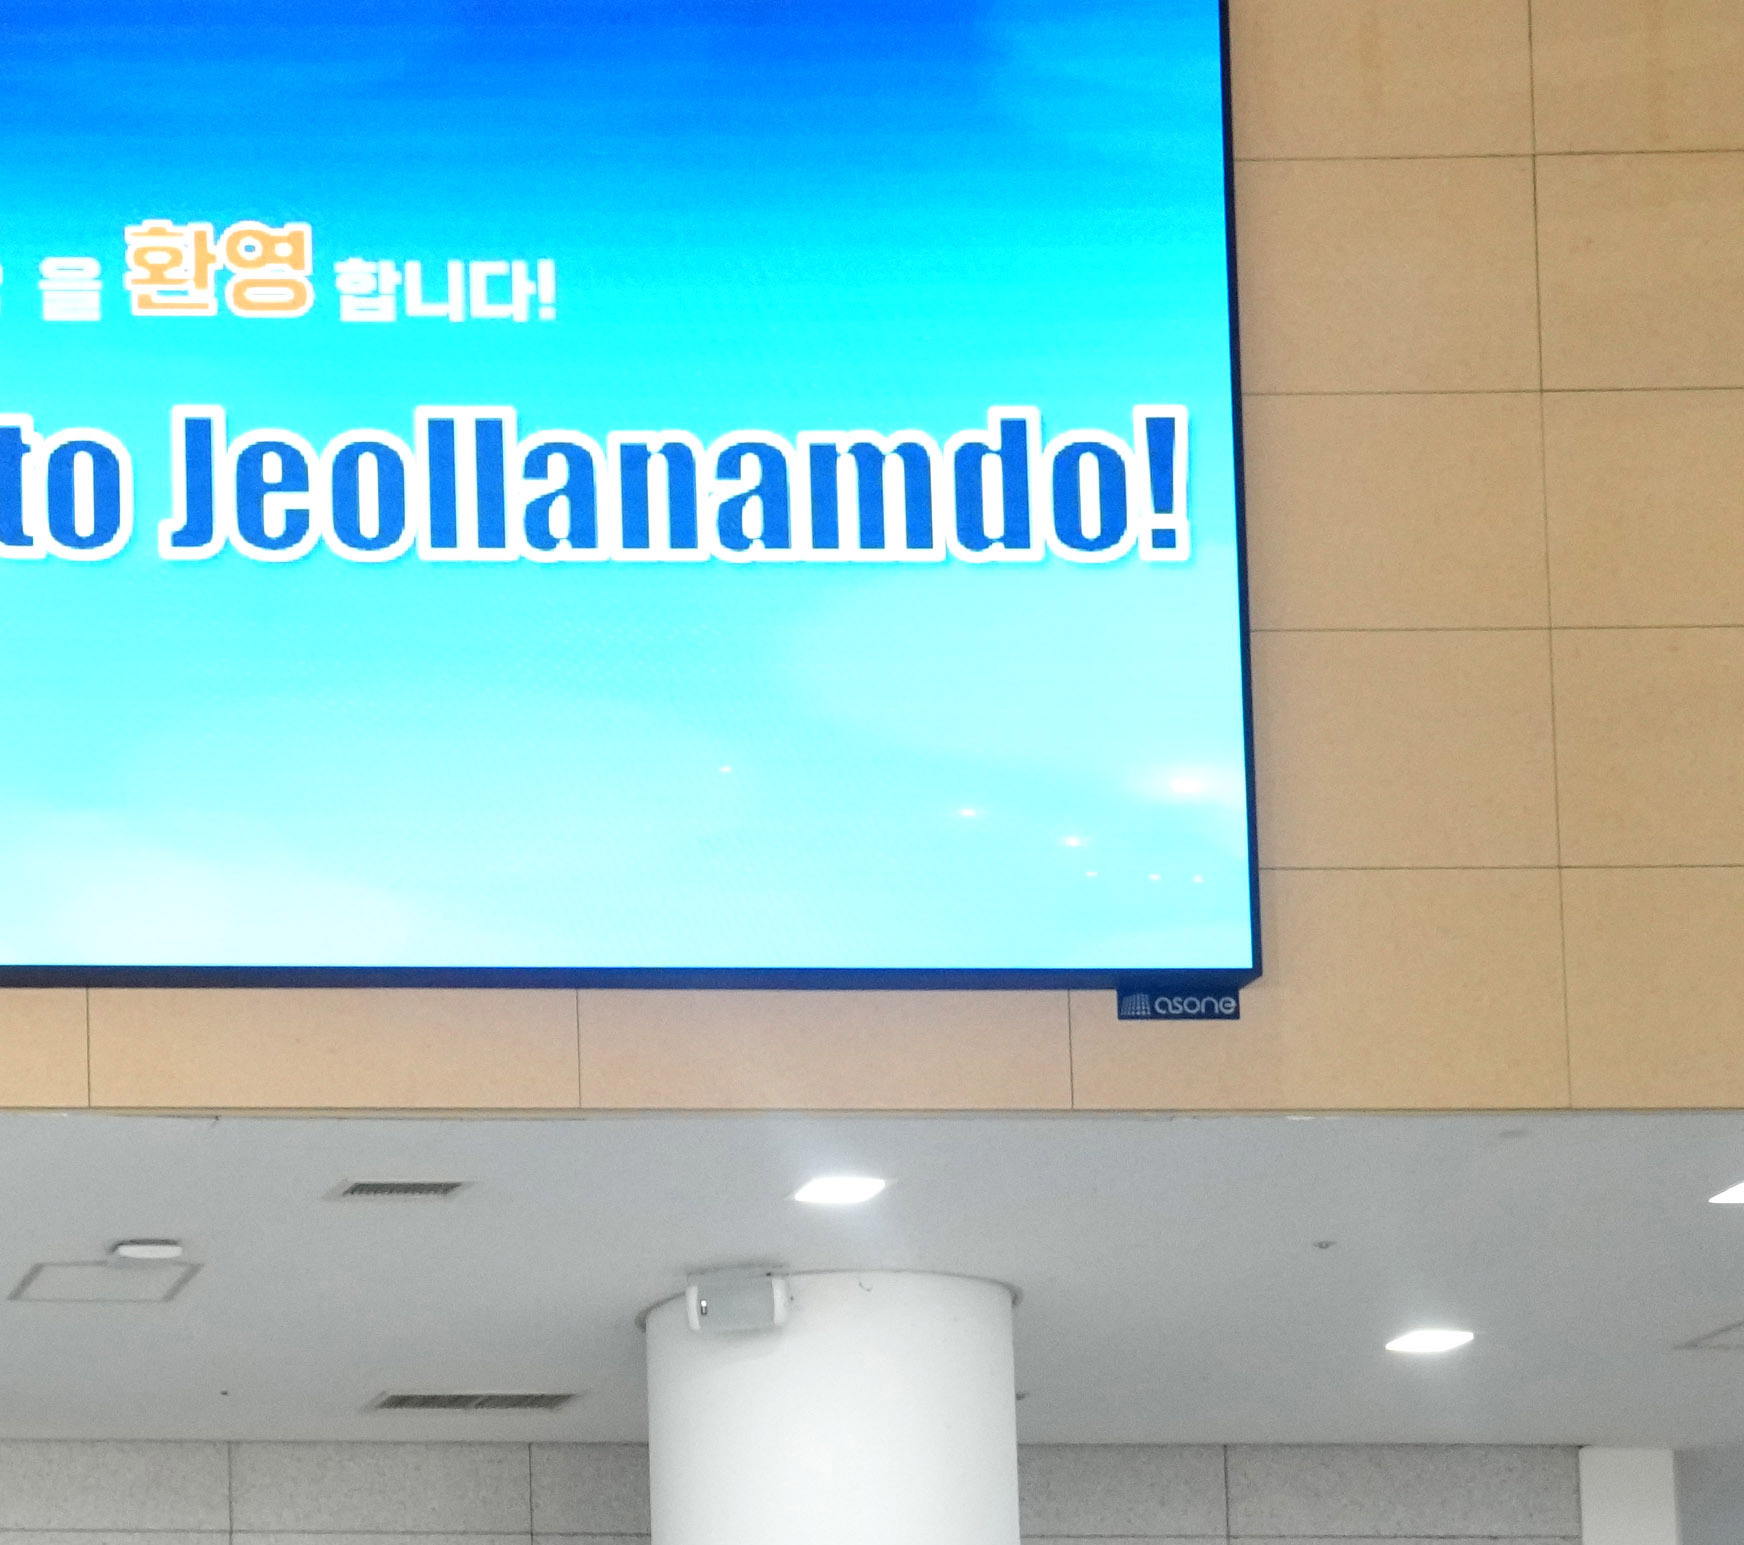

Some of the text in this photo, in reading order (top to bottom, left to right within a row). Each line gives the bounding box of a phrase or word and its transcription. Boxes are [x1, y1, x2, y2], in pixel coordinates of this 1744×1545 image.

[40, 258, 101, 320] 을
[125, 220, 314, 317] 환영
[336, 259, 554, 321] 합니다!
[169, 416, 1180, 552] Jeollanamdo!
[1154, 996, 1236, 1015] asone
